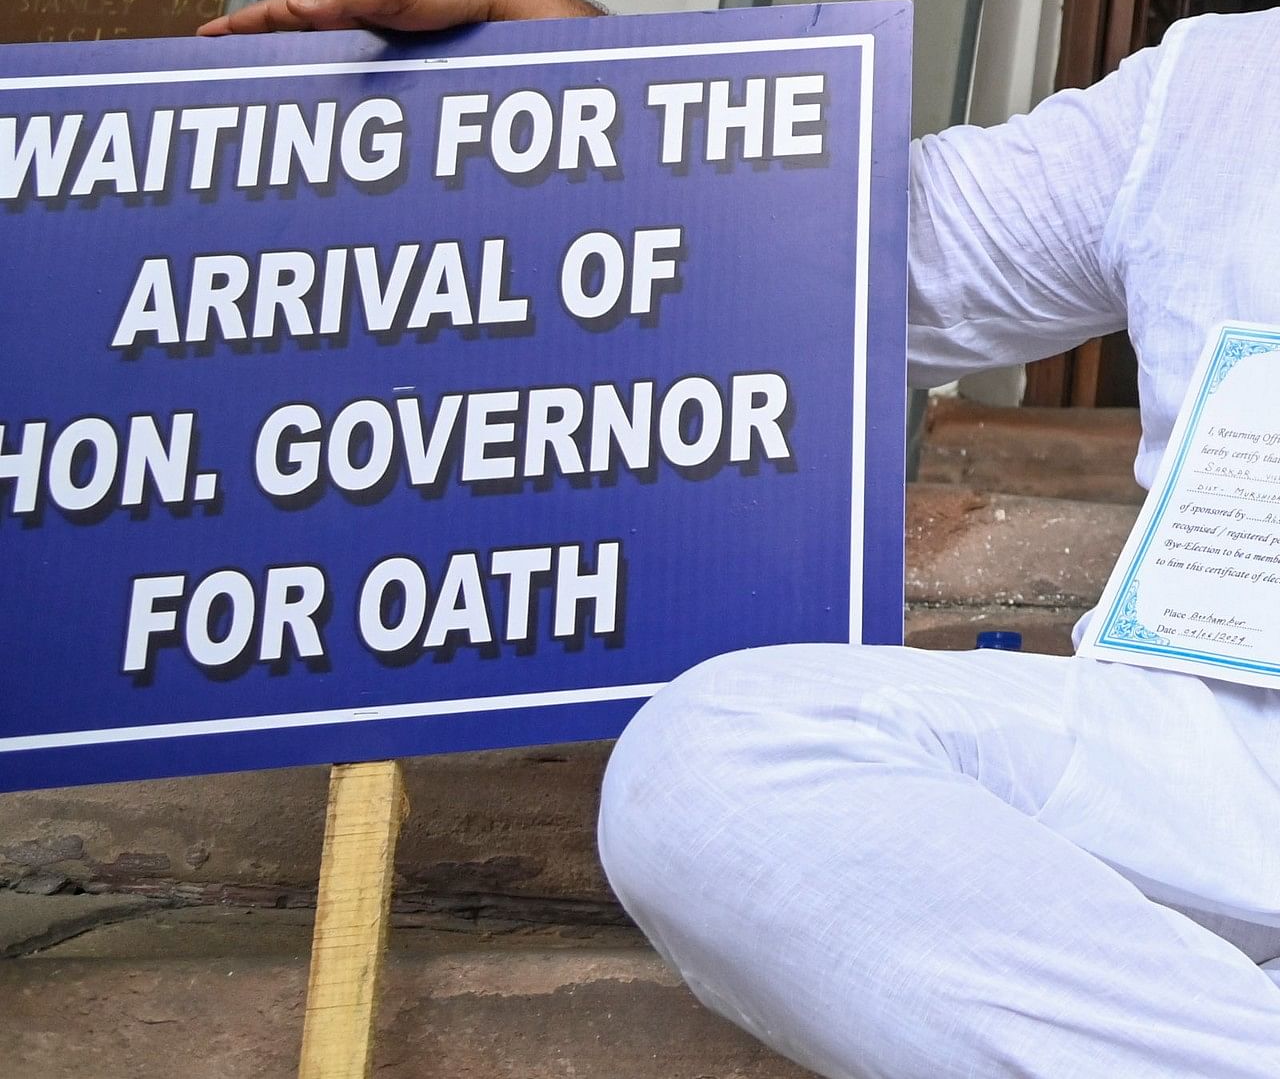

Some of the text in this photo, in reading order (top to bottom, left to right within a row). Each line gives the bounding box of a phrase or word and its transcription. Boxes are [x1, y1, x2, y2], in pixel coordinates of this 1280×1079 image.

[0, 75, 823, 198] WAITING FOR THE
[112, 229, 680, 345] ARRIVAL OF
[0, 374, 789, 512] HON. GOVERNOR
[1201, 444, 1228, 459] hereby
[1231, 451, 1260, 464] certify
[1208, 427, 1214, 436] I,
[1218, 428, 1261, 444] Returning
[125, 543, 618, 670] FOR OATH
[1156, 624, 1176, 635] Date
[1163, 608, 1186, 619] Place
